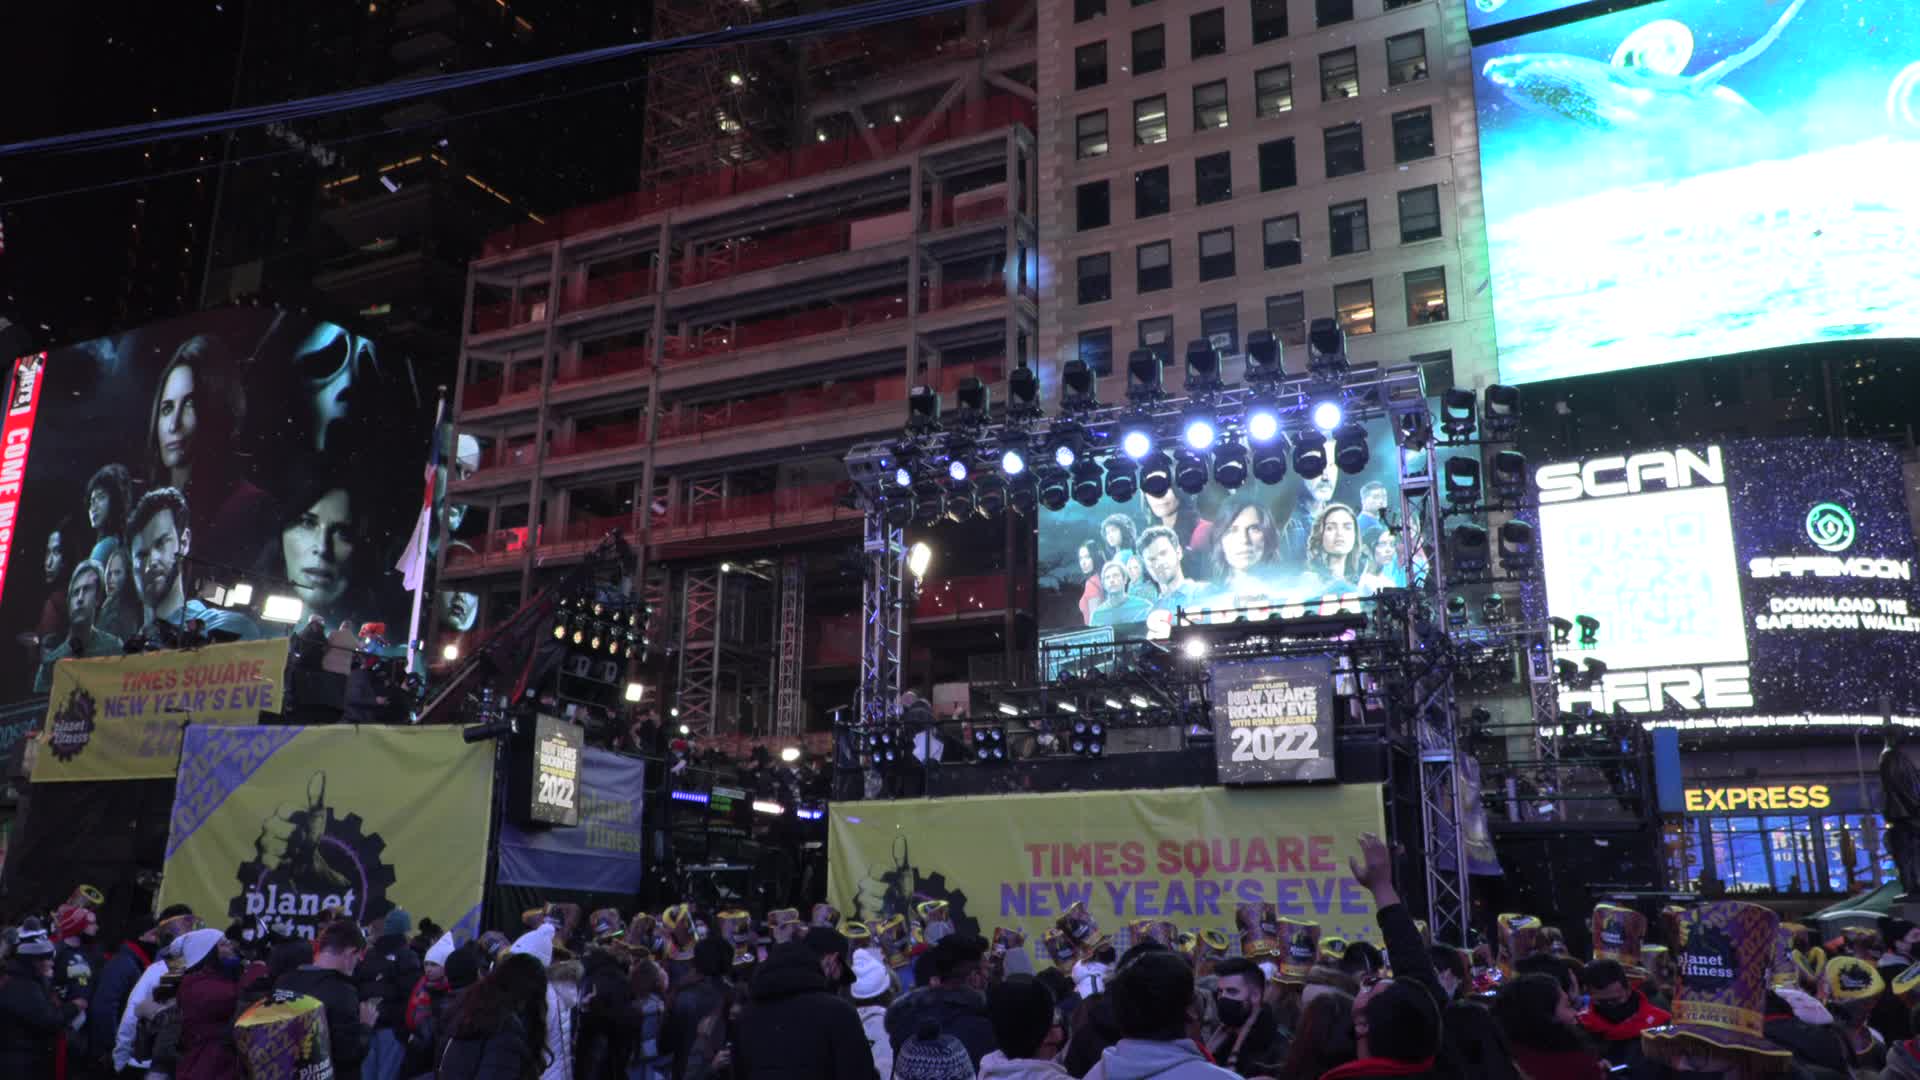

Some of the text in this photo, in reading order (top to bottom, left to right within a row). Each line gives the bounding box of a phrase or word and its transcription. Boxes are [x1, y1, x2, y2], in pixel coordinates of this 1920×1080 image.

[0, 427, 29, 496] COME
[1535, 446, 1725, 504] SCAN
[1749, 556, 1911, 580] SAFEMOON
[1770, 597, 1908, 615] DOWNLOAD THE
[1755, 614, 1920, 632] SAFEMOON WALLET
[122, 660, 264, 692] TIMES SQUARE
[1557, 665, 1753, 714] HERE
[104, 684, 274, 718] NEW YEAR'S EVE
[1228, 690, 1263, 705] NEW
[1287, 700, 1317, 716] EVE
[1231, 724, 1319, 762] 2022
[538, 773, 575, 808] 2022
[1684, 784, 1831, 812] EXPRESS
[1024, 836, 1337, 880] TIMES SQUARE
[1001, 877, 1370, 917] NEW YEAR'S EVE
[1681, 962, 1734, 978] fitness
